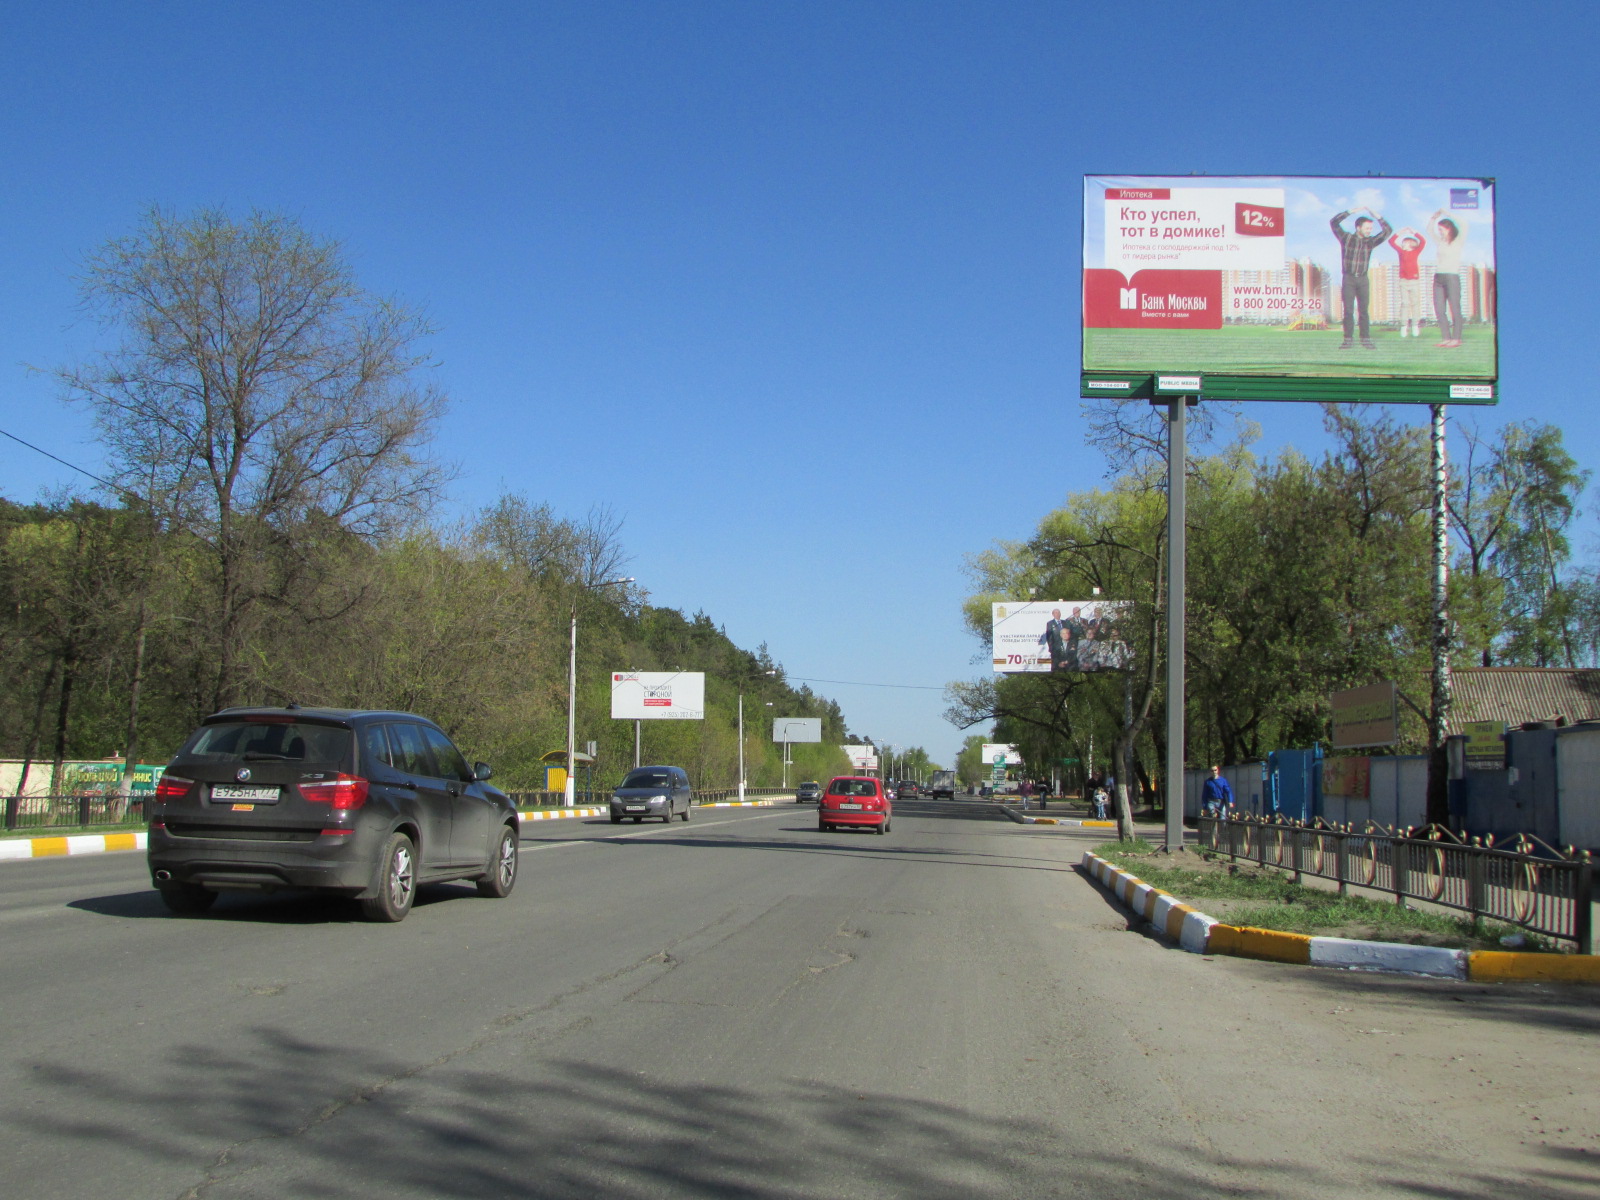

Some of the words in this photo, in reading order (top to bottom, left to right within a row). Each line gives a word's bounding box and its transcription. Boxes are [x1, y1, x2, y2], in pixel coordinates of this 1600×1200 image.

[1119, 189, 1153, 199] Ипотека
[1120, 207, 1147, 221] Кто
[1151, 209, 1201, 224] успел,
[1241, 208, 1275, 229] 12%
[1120, 226, 1144, 238] тот
[1150, 227, 1159, 237] в
[1162, 224, 1226, 240] домике!
[1122, 243, 1151, 251] Ипотека
[1157, 243, 1210, 253] господдержкой
[1211, 244, 1224, 252] под
[1225, 244, 1240, 252] 12%
[1132, 253, 1156, 262] лидера
[1233, 284, 1299, 296] www.bm.ru
[1141, 293, 1165, 310] Банк
[1168, 294, 1207, 311] Москвы
[1233, 299, 1240, 310] 8
[1243, 299, 1264, 310] 800
[1266, 298, 1322, 310] 200-23-26
[1007, 654, 1022, 665] 70
[120, 772, 152, 783] ТННИС
